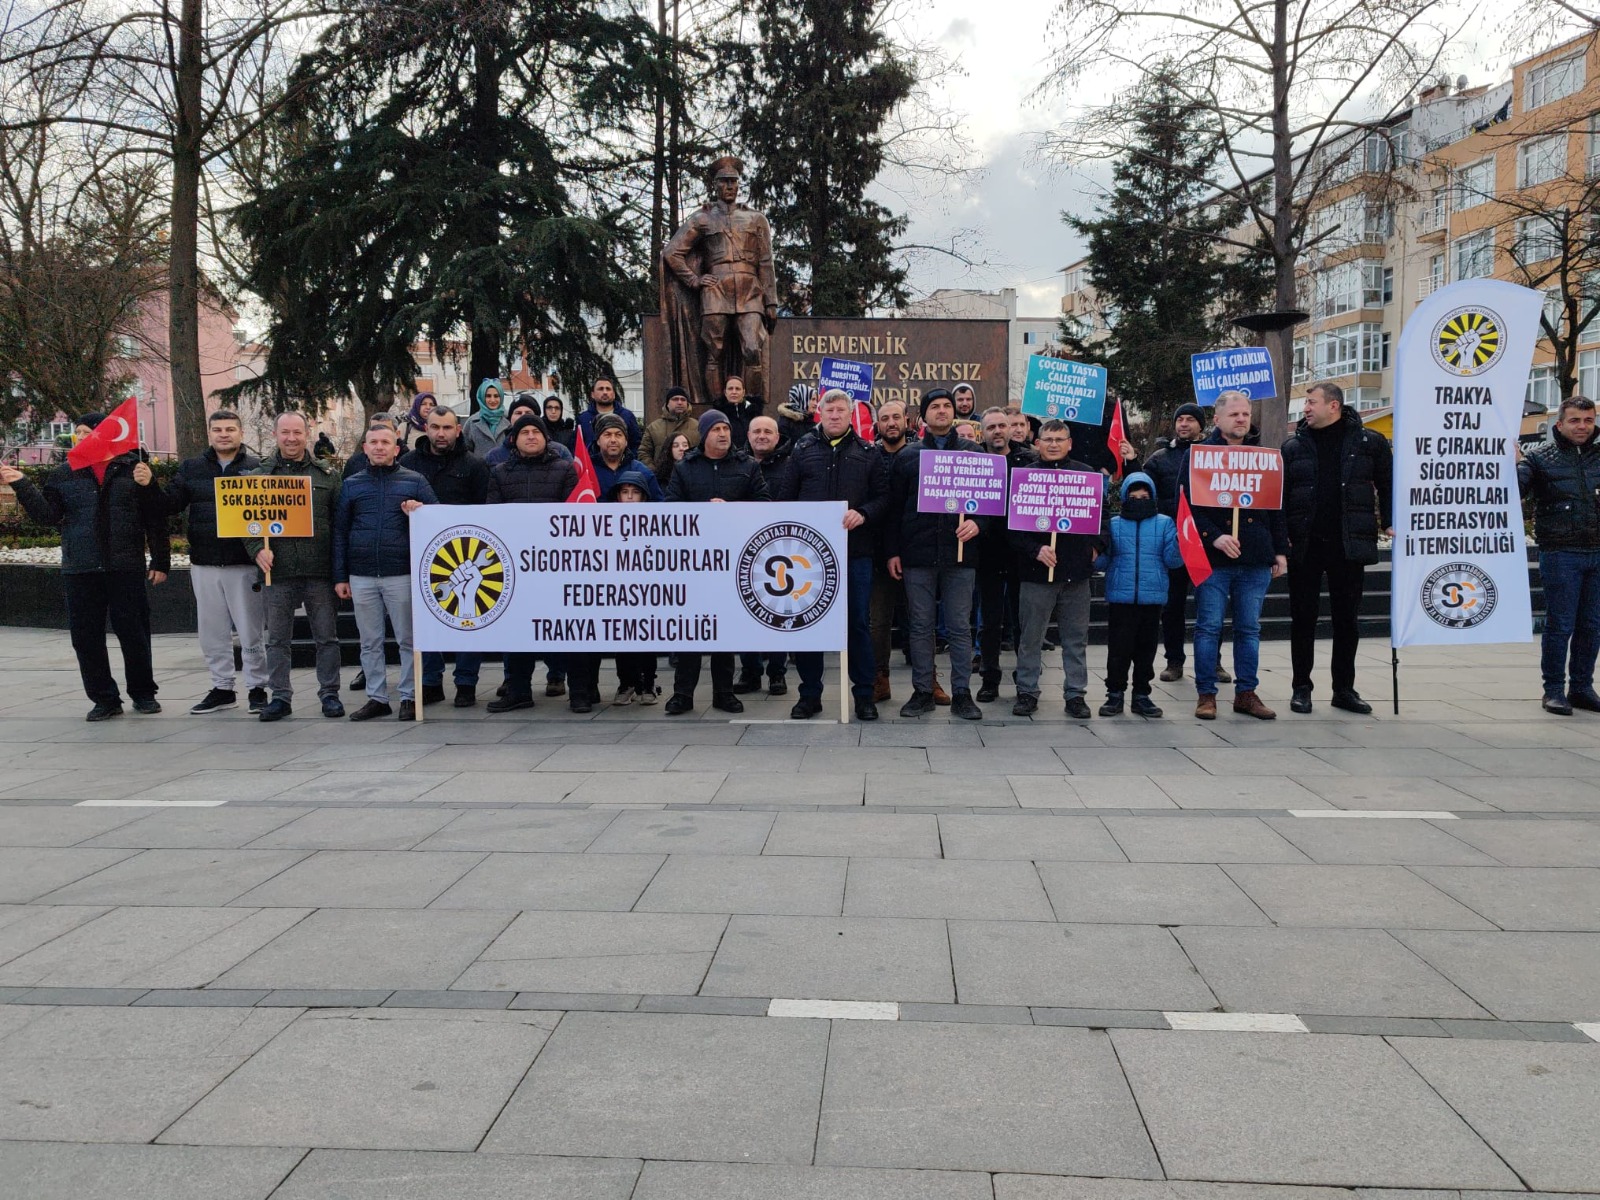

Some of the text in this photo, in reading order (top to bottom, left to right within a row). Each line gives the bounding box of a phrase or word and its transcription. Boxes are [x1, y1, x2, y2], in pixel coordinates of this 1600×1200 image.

[793, 331, 907, 355] EGEMENLİK
[832, 362, 861, 374] KURSİYER,
[1196, 352, 1267, 372] STAJ VE ÇIRAKLIK
[899, 363, 981, 382] ŞARTSIZ
[1197, 370, 1270, 391] FİİLİ ÇALIŞMADIR
[821, 377, 845, 388] ÖĞRENCİ
[1035, 379, 1096, 398] SİGORTAMIZI
[1047, 392, 1081, 406] İSTERİZ
[1435, 387, 1492, 405] TRAKYA
[1444, 412, 1480, 430] STAJ
[1416, 437, 1506, 457] VE ÇIRAKLIK
[934, 465, 994, 476] SON VERİLSİN!
[935, 456, 993, 466] HAK GASBINA
[1194, 451, 1278, 471] HAK HUKUK
[1420, 459, 1499, 480] SİGORTASI
[221, 479, 305, 492] STAJ VE ÇIRAKLIK
[924, 476, 1002, 488] STAJ VE ÇIRAKLIK SGK
[1028, 473, 1086, 484] SOSYAL DEVLET
[1210, 473, 1262, 492] ADALET
[924, 488, 1001, 500] BAŞLANGICI OLSUN
[1019, 484, 1094, 496] SOSYAL SORUNLARI
[1410, 483, 1508, 506] MAĞDURLARI
[223, 495, 305, 509] SGK BAŞLANGICI
[1012, 492, 1045, 506] ÇÖZMEK
[1066, 497, 1099, 508] VARDIR.
[243, 510, 287, 520] OLSUN
[1055, 506, 1092, 518] SÖYLEMİ.
[1411, 512, 1508, 531] FEDERASYON
[550, 514, 700, 541] STAJ VE ÇIRAKLIK
[748, 526, 788, 553] SİGORTASI
[791, 526, 834, 566] MAĞDURLARI
[1406, 532, 1514, 556] İL TEMSİLCİLİĞİ
[520, 545, 729, 572] SİGORTASI MAĞDURLARI
[564, 584, 686, 606] FEDERASYONU
[745, 596, 756, 608] VE
[803, 569, 836, 623] FEDERASYONU
[754, 604, 774, 623] STAJ
[532, 614, 717, 641] TRAKYA TEMSİLCİLİĞİ
